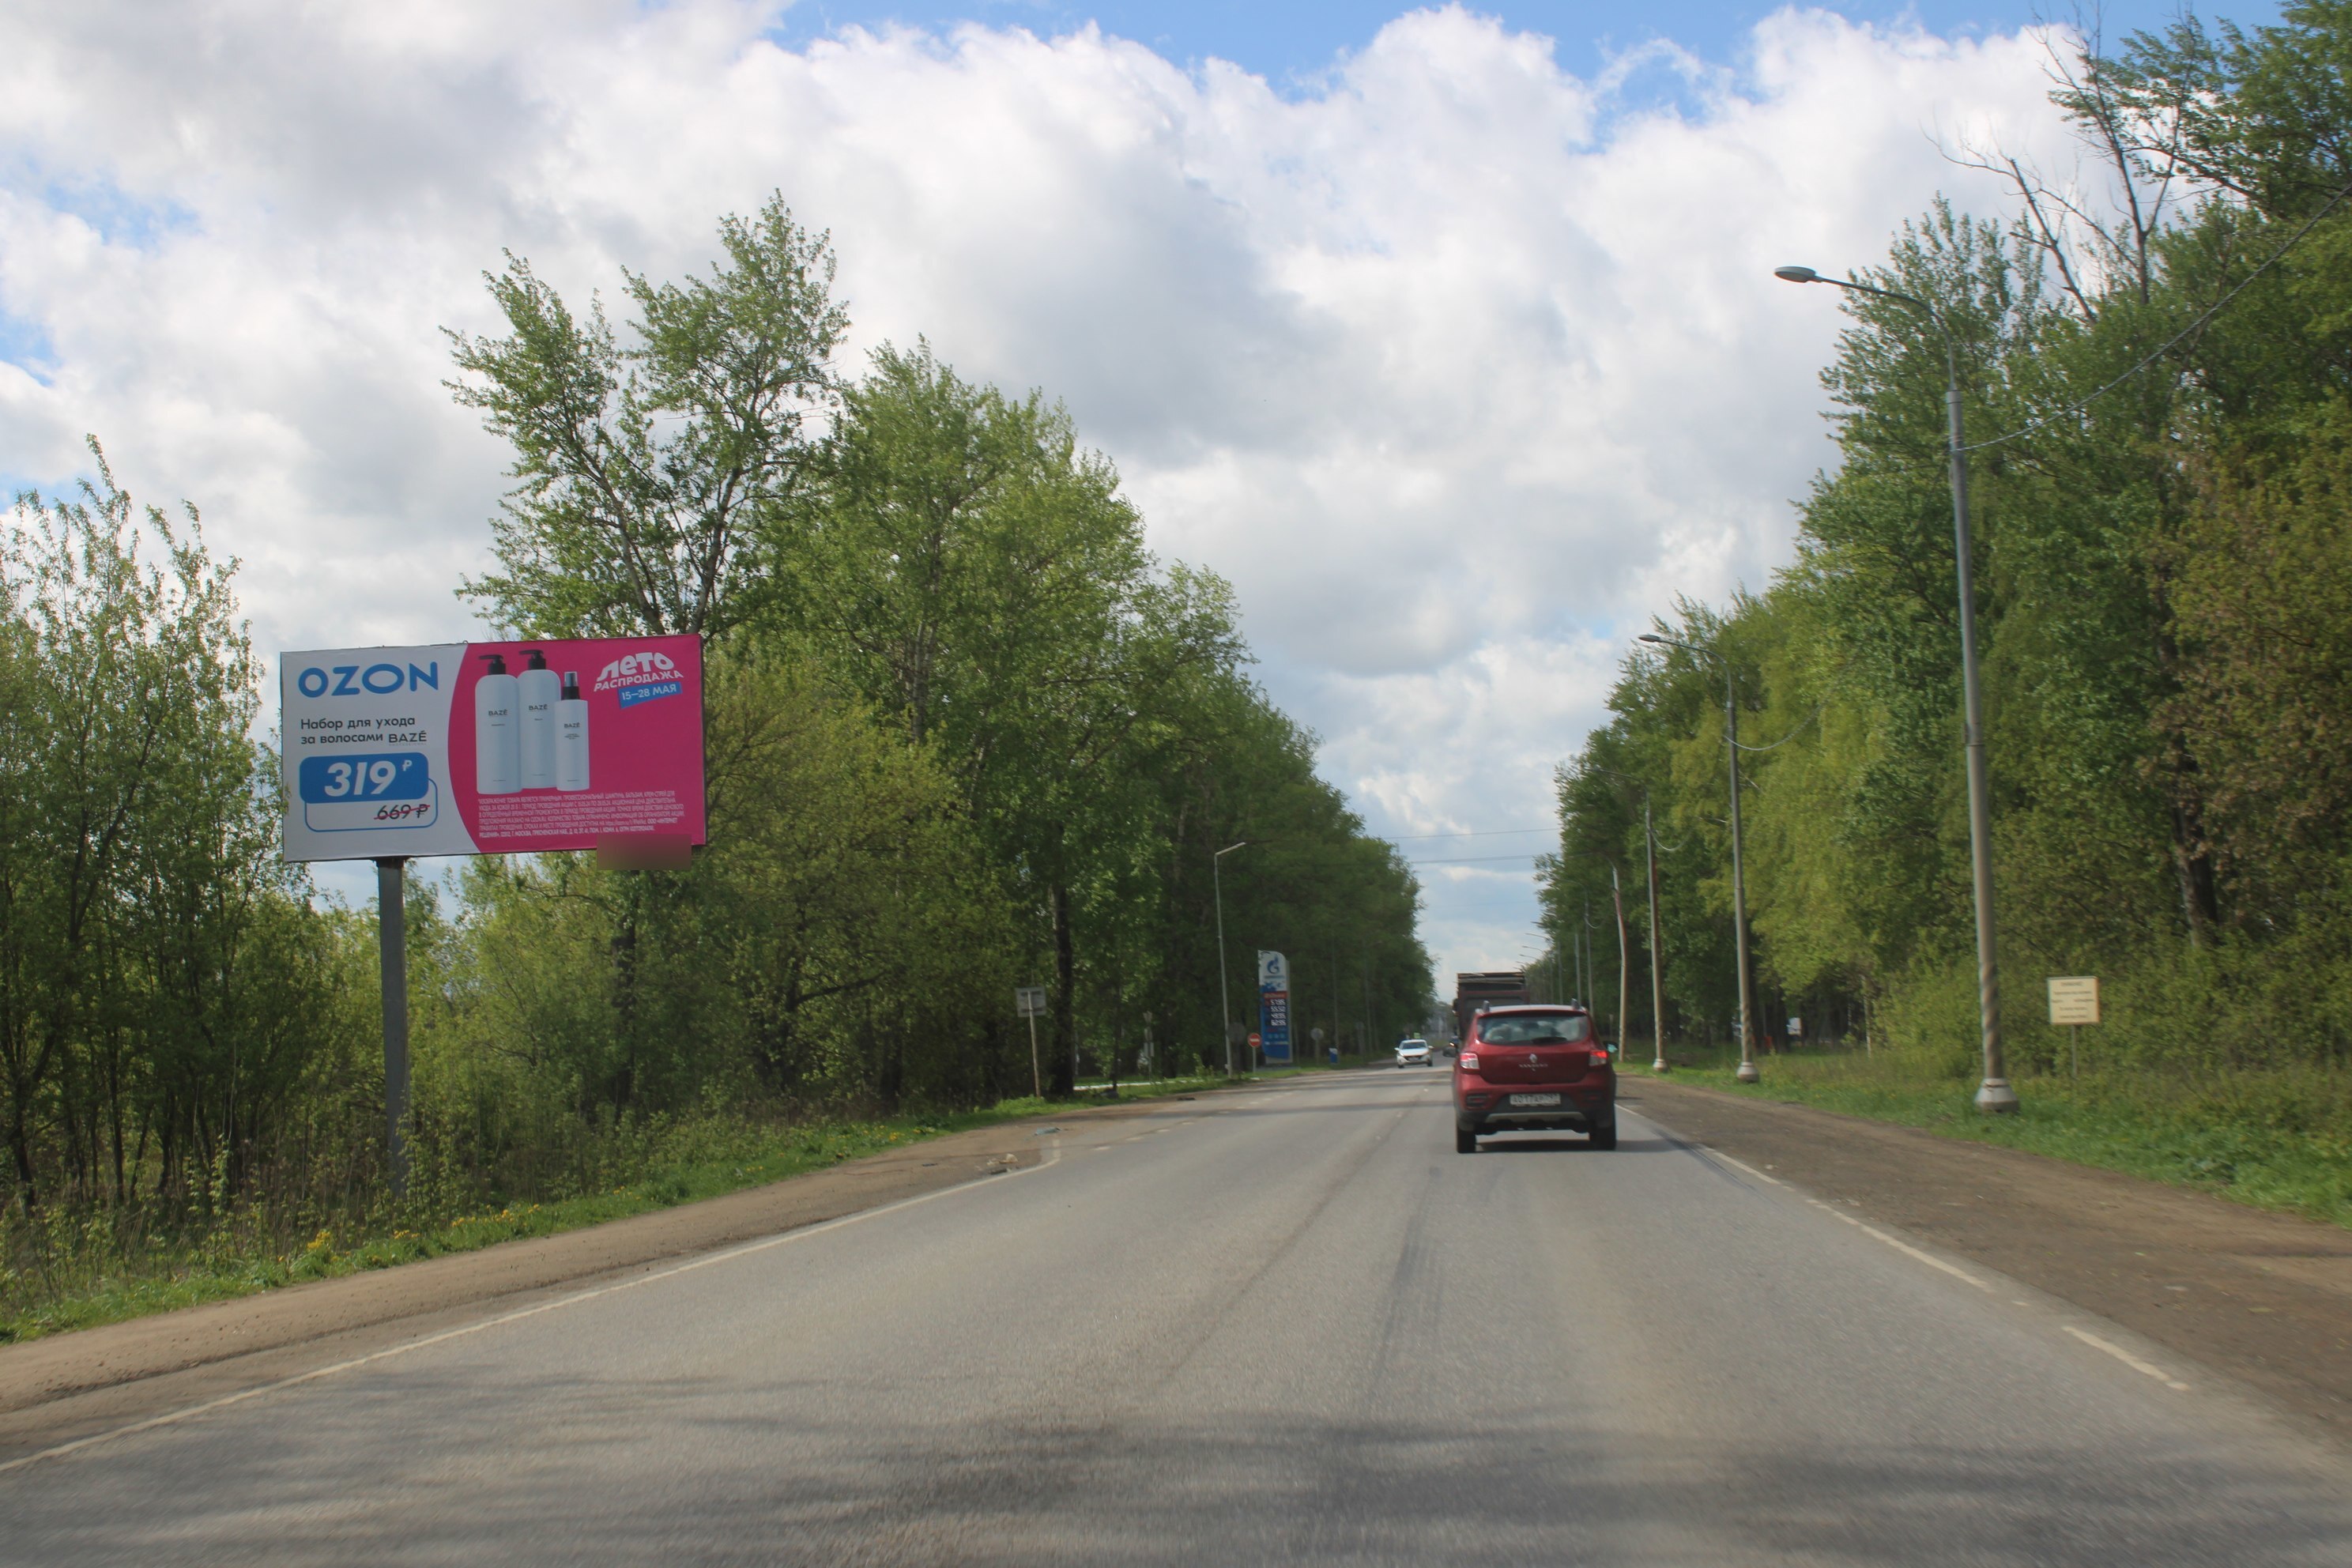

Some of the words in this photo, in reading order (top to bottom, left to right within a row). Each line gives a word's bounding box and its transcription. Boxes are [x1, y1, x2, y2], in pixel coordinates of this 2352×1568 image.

[298, 662, 439, 698] OZON
[594, 670, 684, 692] РАСПРОДАЖА
[652, 684, 677, 695] МАЯ
[300, 718, 343, 730] Набор
[348, 718, 371, 729] для
[376, 717, 416, 729] ухода
[300, 736, 315, 744] за
[320, 733, 383, 744] волосами
[388, 730, 427, 744] BAZÉ
[324, 760, 396, 797] 319
[377, 804, 412, 820] 669
